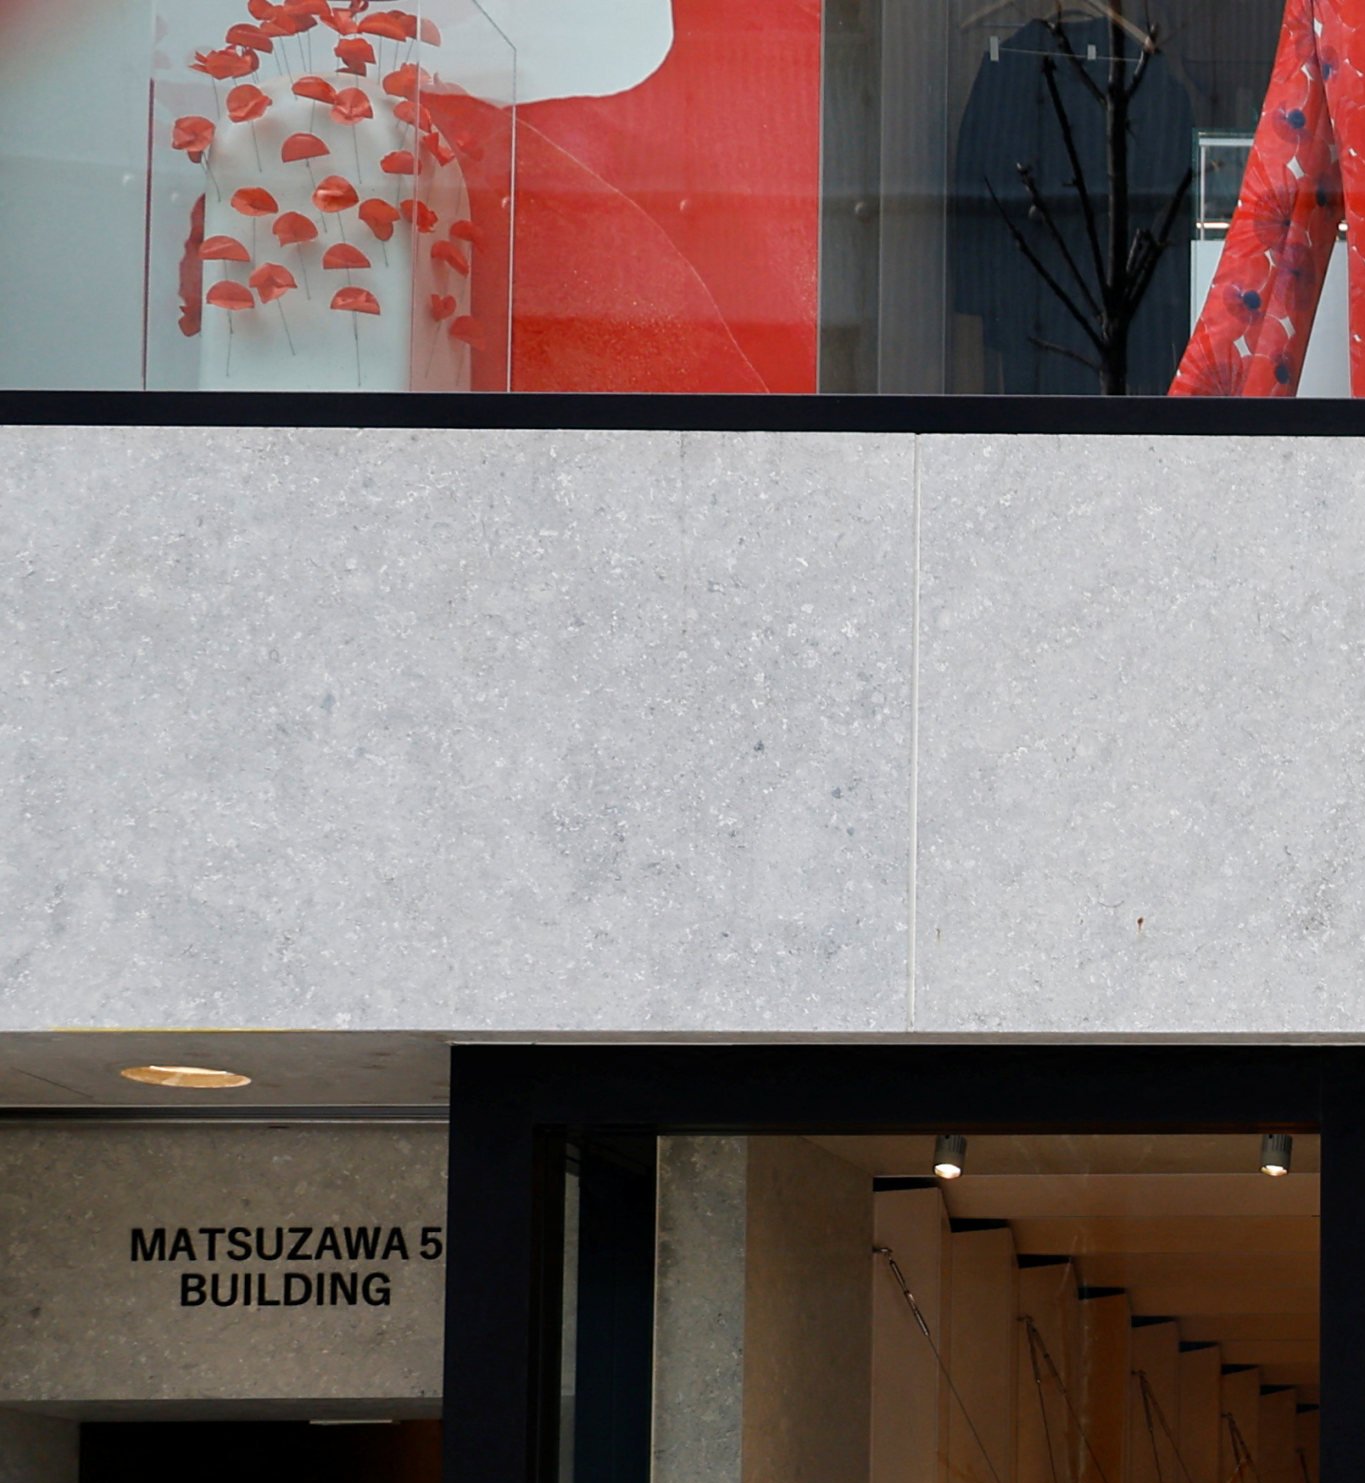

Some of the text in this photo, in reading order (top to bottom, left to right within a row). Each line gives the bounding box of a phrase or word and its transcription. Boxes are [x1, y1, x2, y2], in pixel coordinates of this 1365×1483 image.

[130, 1226, 443, 1262] MATSUZAWA 5
[179, 1271, 392, 1307] BUILDING
